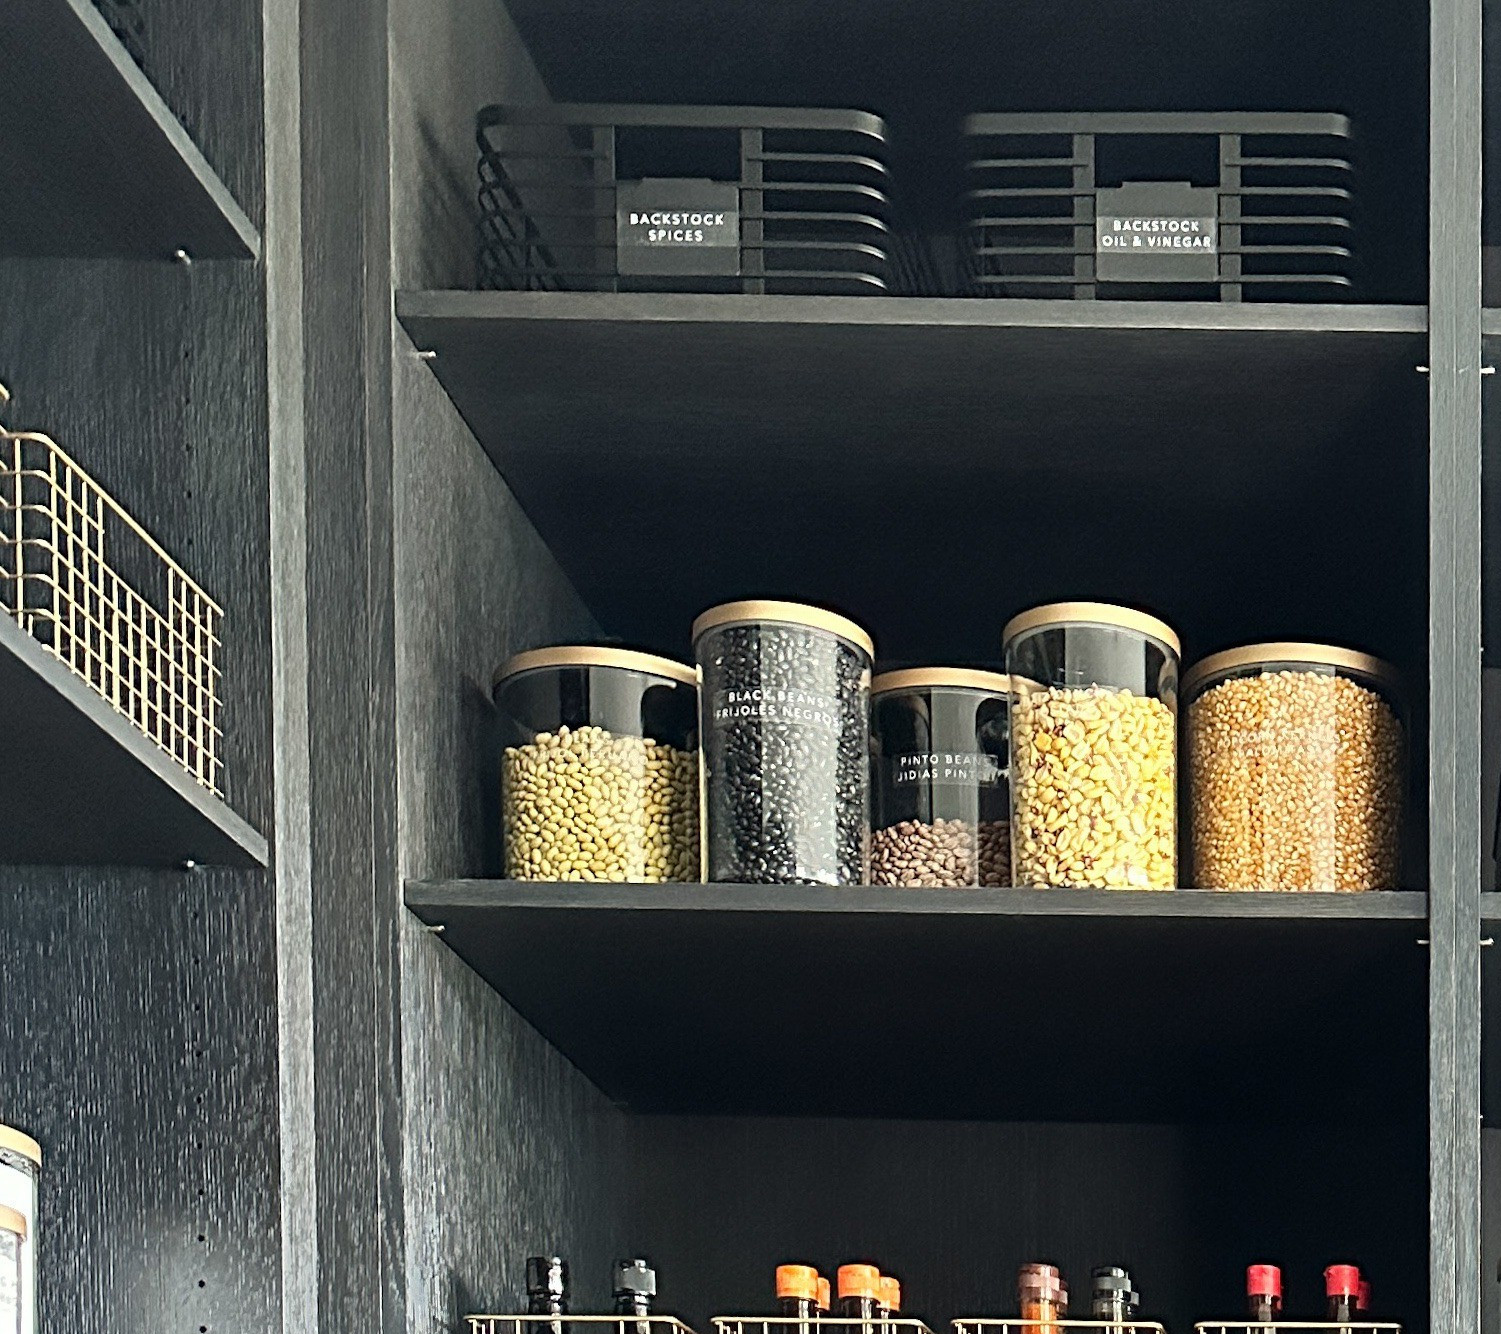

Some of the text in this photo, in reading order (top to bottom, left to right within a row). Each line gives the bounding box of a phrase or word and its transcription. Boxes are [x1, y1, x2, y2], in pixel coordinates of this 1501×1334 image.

[629, 212, 725, 226] BACKSTOCK
[1112, 220, 1200, 232] BACKSTOCK
[647, 229, 704, 242] SPICES
[1101, 234, 1212, 248] OIL & VINEGAR
[728, 689, 771, 702] BLACK
[900, 754, 939, 767] PINTO
